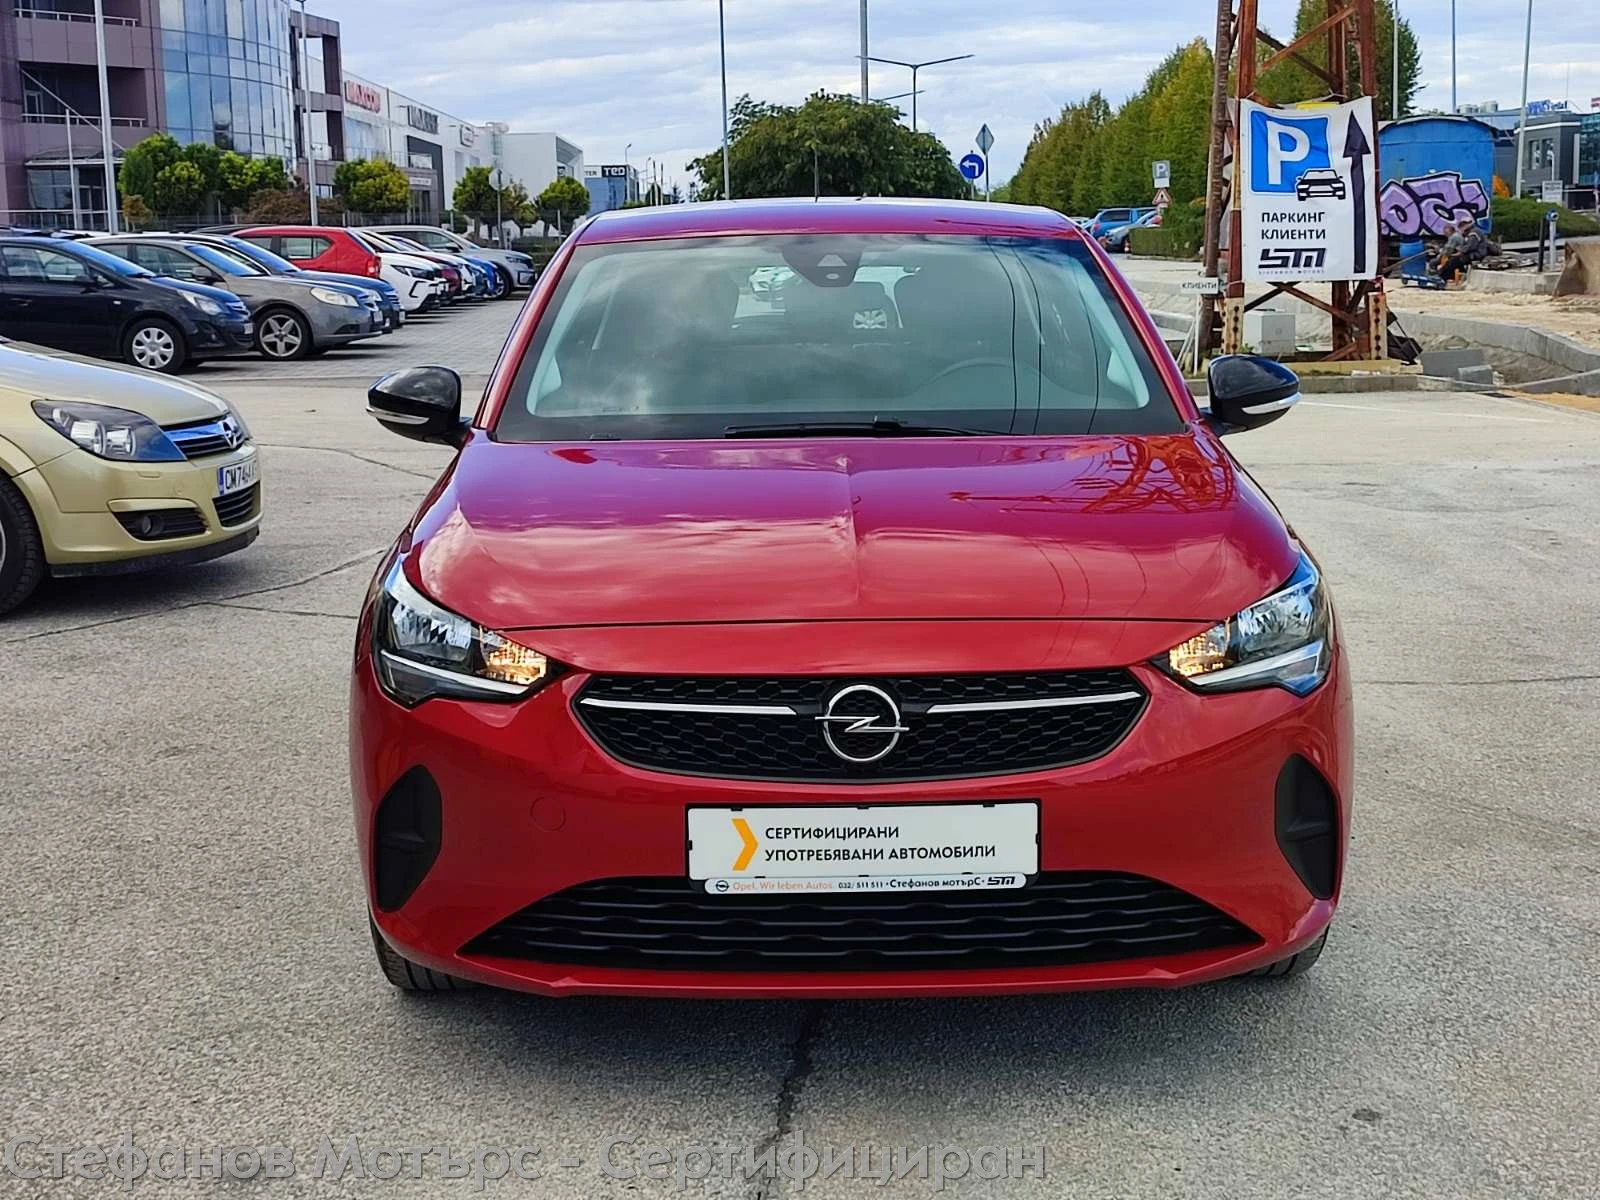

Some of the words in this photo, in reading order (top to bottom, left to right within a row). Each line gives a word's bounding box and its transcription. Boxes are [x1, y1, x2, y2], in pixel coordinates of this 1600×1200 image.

[1266, 120, 1310, 185] P
[1156, 163, 1166, 177] P
[1261, 212, 1325, 223] ПАРКИНГ
[1261, 229, 1326, 240] КЛИЕНТИ
[765, 827, 899, 841] СЕРТИФИЦИРАНИ
[765, 848, 884, 861] УПОТРЕБЯВАНИ
[888, 846, 996, 859] АВТОМОБИЛИ
[777, 881, 803, 889] leben
